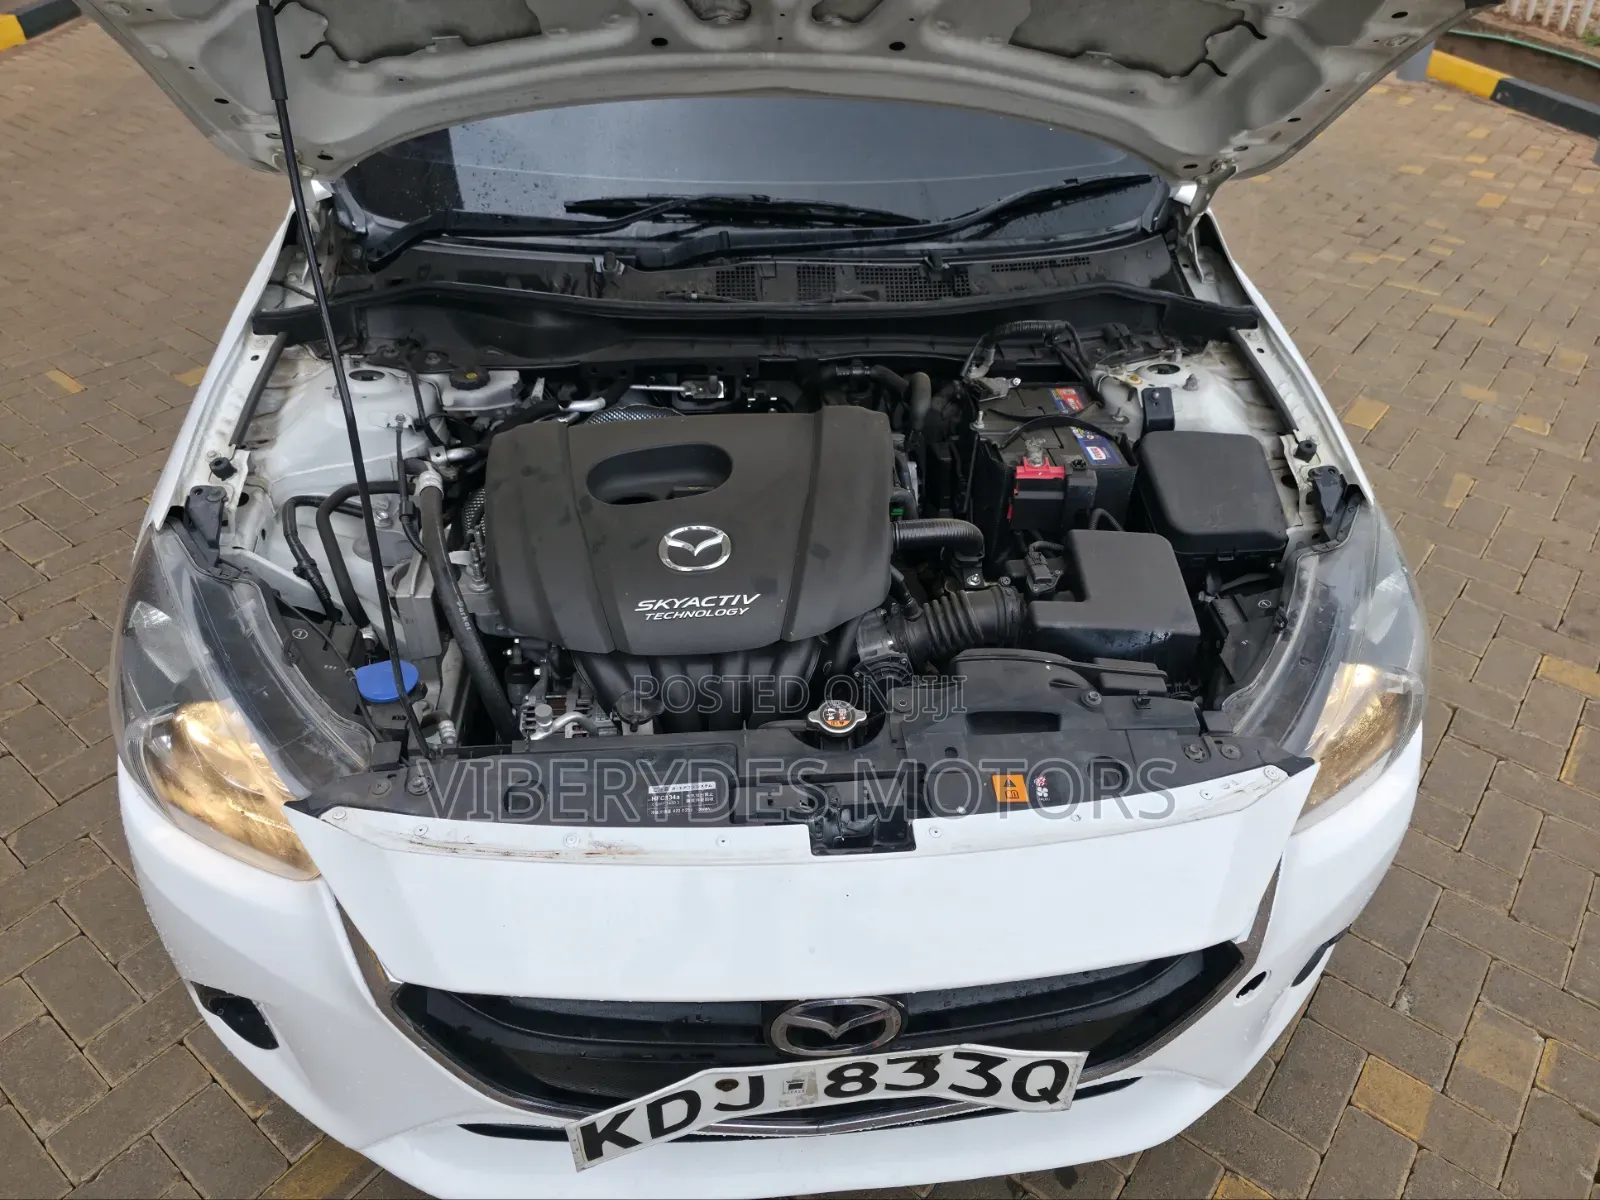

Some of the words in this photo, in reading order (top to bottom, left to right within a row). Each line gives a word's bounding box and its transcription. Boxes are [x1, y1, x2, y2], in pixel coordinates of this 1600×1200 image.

[634, 593, 761, 612] SKYACTIV
[645, 607, 750, 621] TECHNOLOGY
[580, 1075, 765, 1162] KDJ
[822, 1051, 1071, 1105] 833Q
